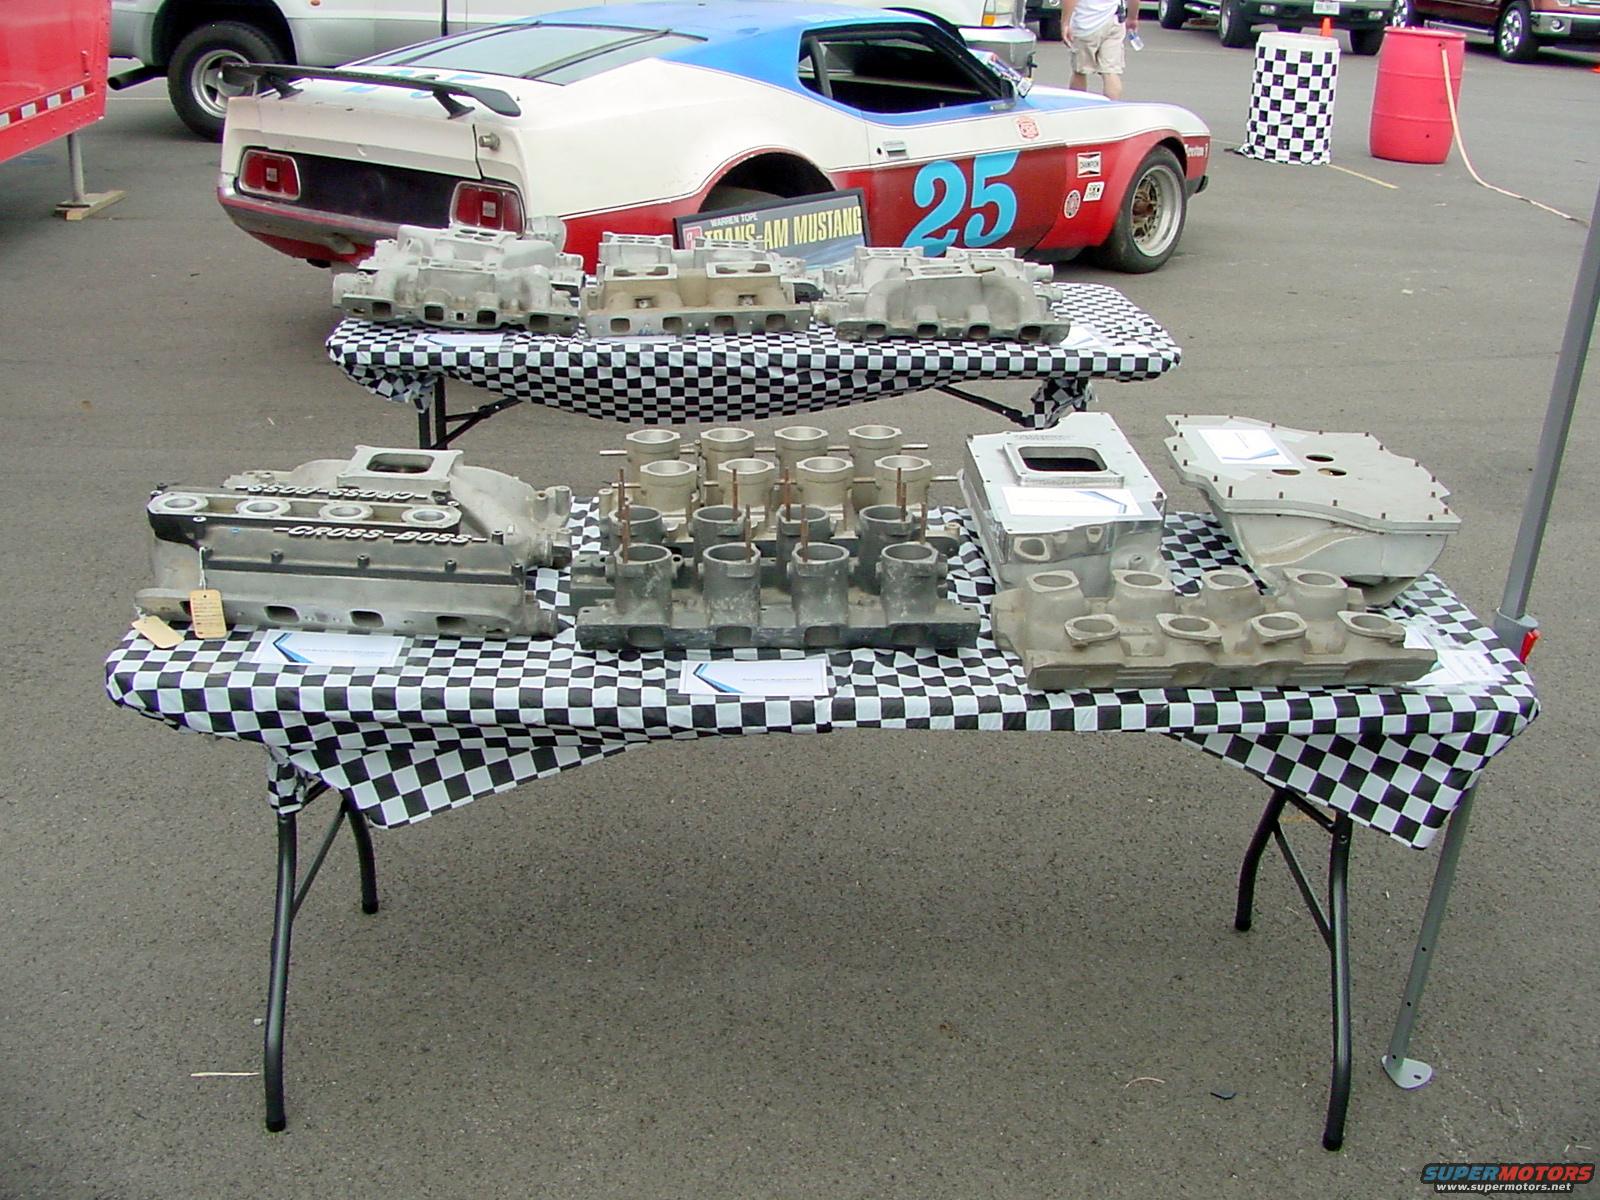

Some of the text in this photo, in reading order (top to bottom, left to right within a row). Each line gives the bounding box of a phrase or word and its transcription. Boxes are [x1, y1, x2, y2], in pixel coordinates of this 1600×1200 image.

[704, 218, 788, 250] ANS-AM
[793, 206, 863, 244] MUSTANG
[902, 150, 1021, 257] 25
